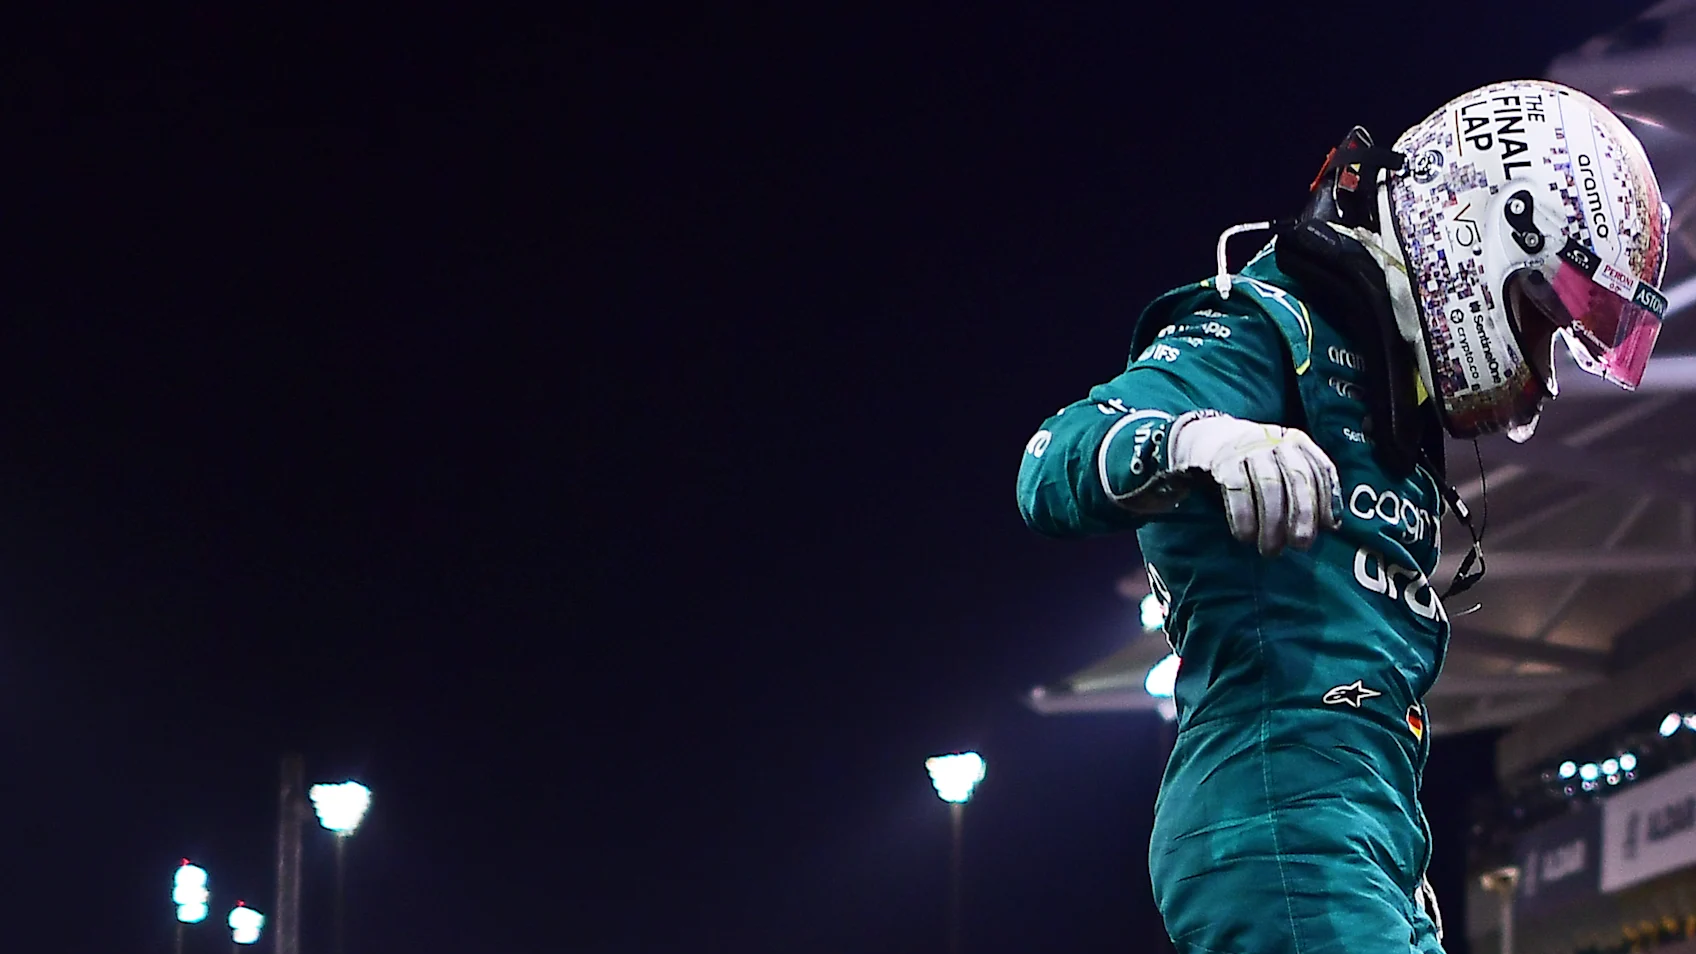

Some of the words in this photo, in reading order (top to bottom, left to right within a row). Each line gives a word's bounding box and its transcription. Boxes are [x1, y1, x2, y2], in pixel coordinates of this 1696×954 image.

[1461, 102, 1493, 152] LAP
[1492, 95, 1532, 181] FINAL
[1525, 94, 1545, 123] THE
[1578, 154, 1609, 239] aramco
[1473, 314, 1502, 384] SentinelOne
